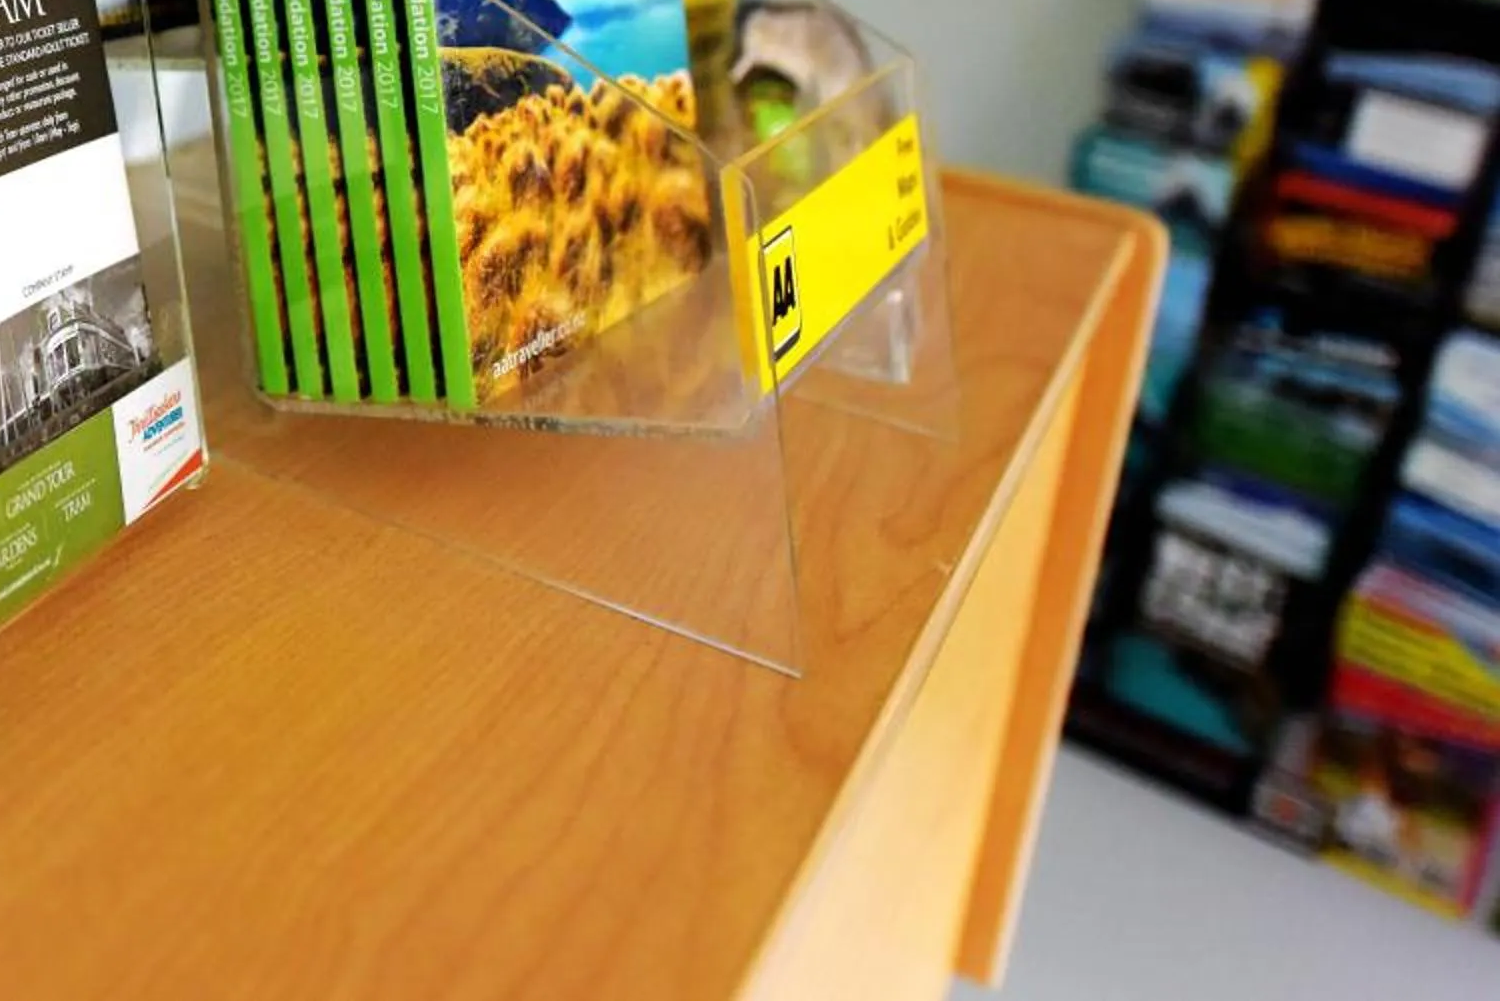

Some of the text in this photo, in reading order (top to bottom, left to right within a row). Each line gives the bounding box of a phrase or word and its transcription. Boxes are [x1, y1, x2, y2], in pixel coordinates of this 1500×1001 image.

[227, 72, 247, 119] 2017
[262, 68, 281, 117] 2017
[299, 72, 319, 119] 2017
[337, 64, 357, 113] 2017
[376, 60, 398, 109] 2017
[417, 64, 440, 116] 2017
[771, 256, 797, 327] AA
[61, 490, 92, 522] TRAM
